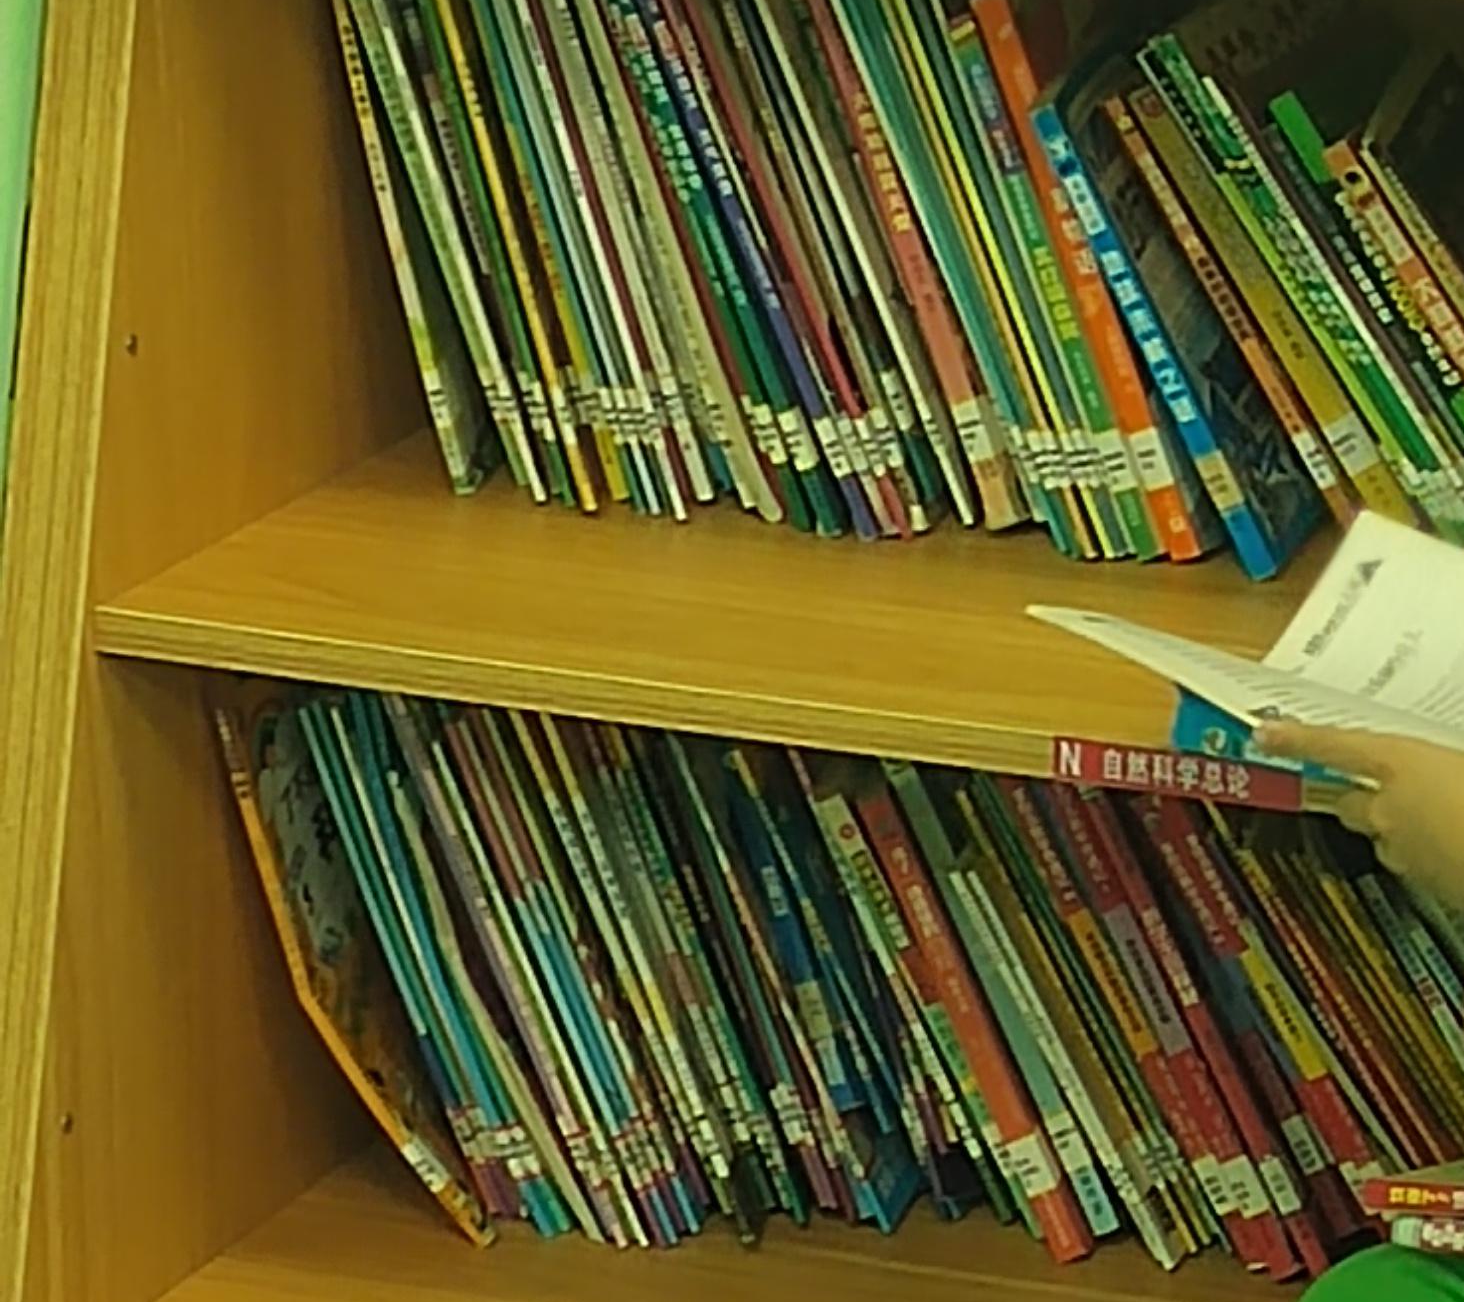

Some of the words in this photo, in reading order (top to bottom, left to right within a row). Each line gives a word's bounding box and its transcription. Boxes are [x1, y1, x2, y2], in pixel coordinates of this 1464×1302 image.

[1057, 742, 1083, 777] N
[1102, 746, 1251, 798] 自然科学总论
